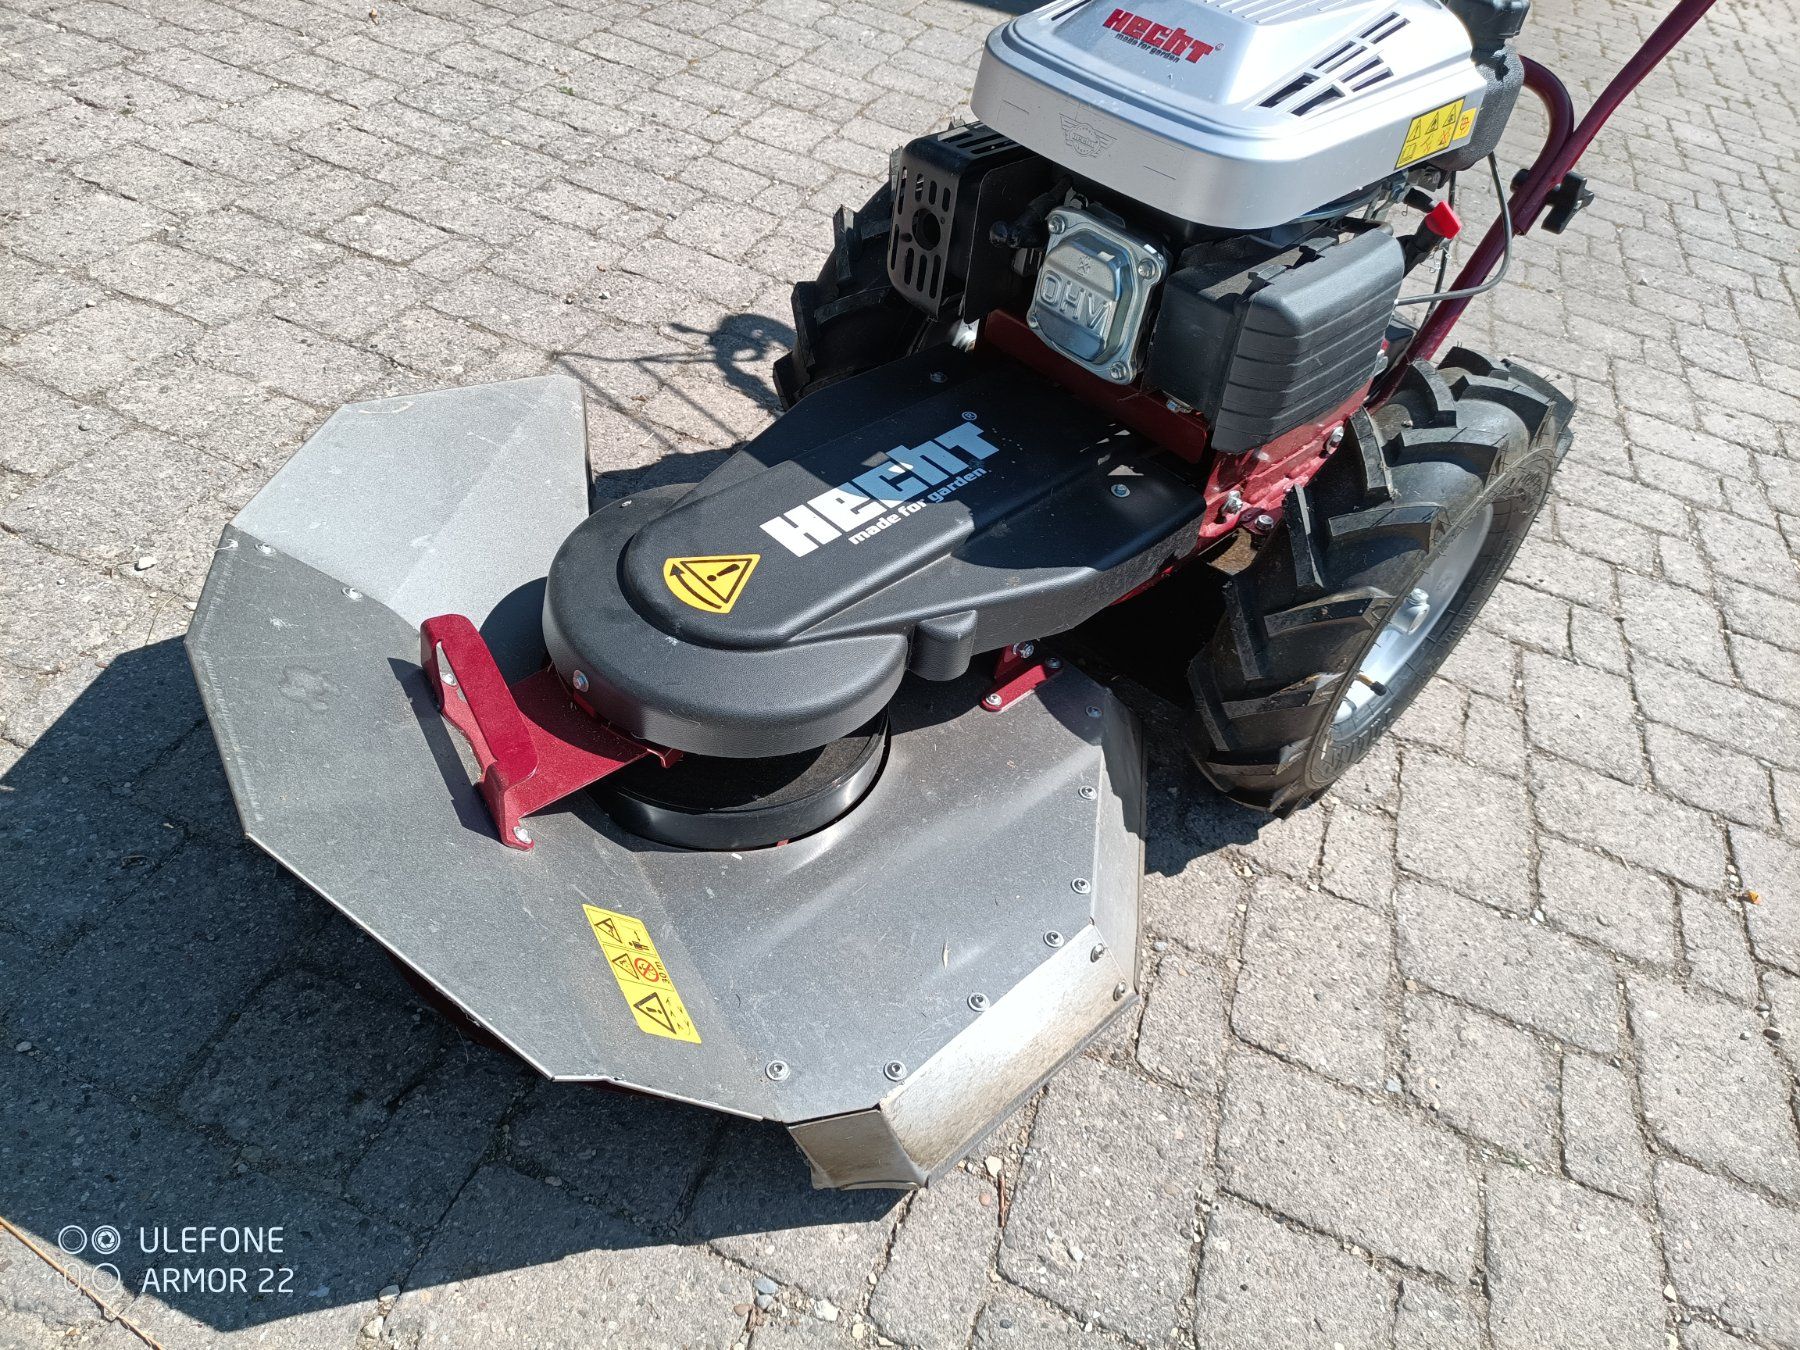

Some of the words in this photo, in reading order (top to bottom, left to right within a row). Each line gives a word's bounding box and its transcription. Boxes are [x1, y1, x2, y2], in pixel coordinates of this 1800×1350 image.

[1115, 33, 1138, 46] made
[1137, 38, 1151, 52] for
[1149, 47, 1180, 63] garden
[1041, 270, 1112, 331] OHV
[848, 513, 901, 545] made
[898, 499, 927, 517] for
[927, 467, 987, 504] garden
